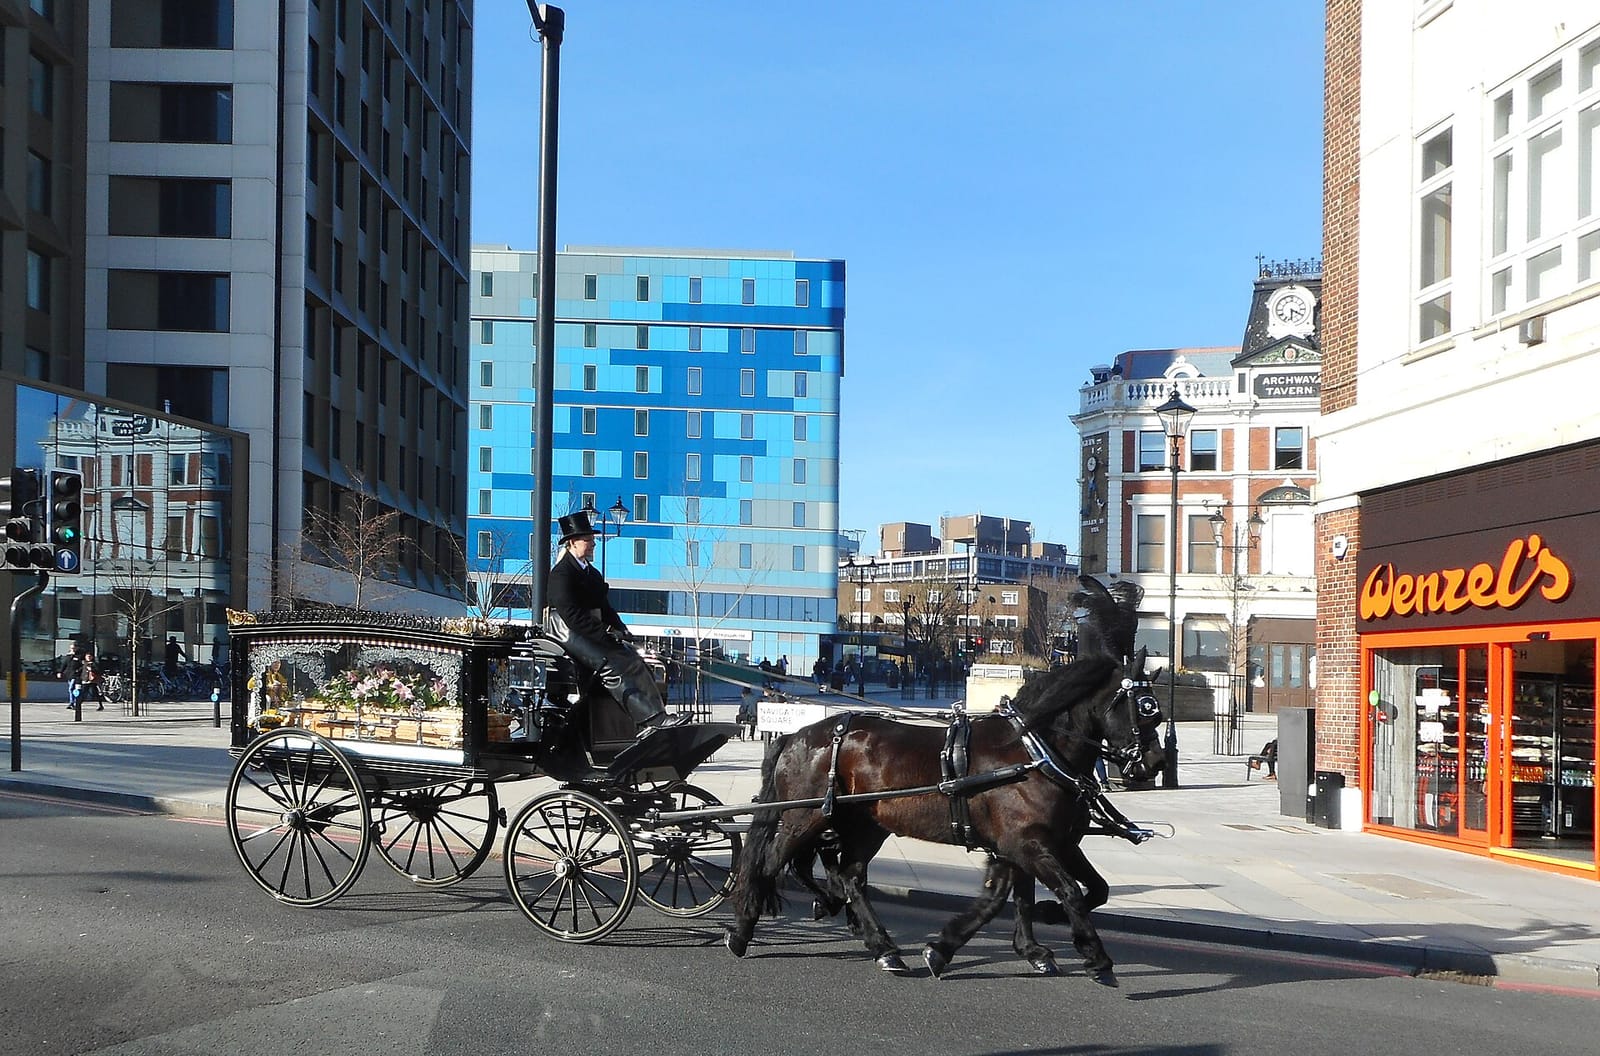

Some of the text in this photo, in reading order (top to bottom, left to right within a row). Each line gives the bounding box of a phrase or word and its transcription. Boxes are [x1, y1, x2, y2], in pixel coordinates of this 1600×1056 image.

[1262, 375, 1318, 385] ARCHWAY
[1265, 386, 1313, 396] TAVERN
[1359, 533, 1570, 621] Wenzel's
[760, 707, 806, 715] NAVIGATOR
[760, 715, 792, 724] SQUARE
